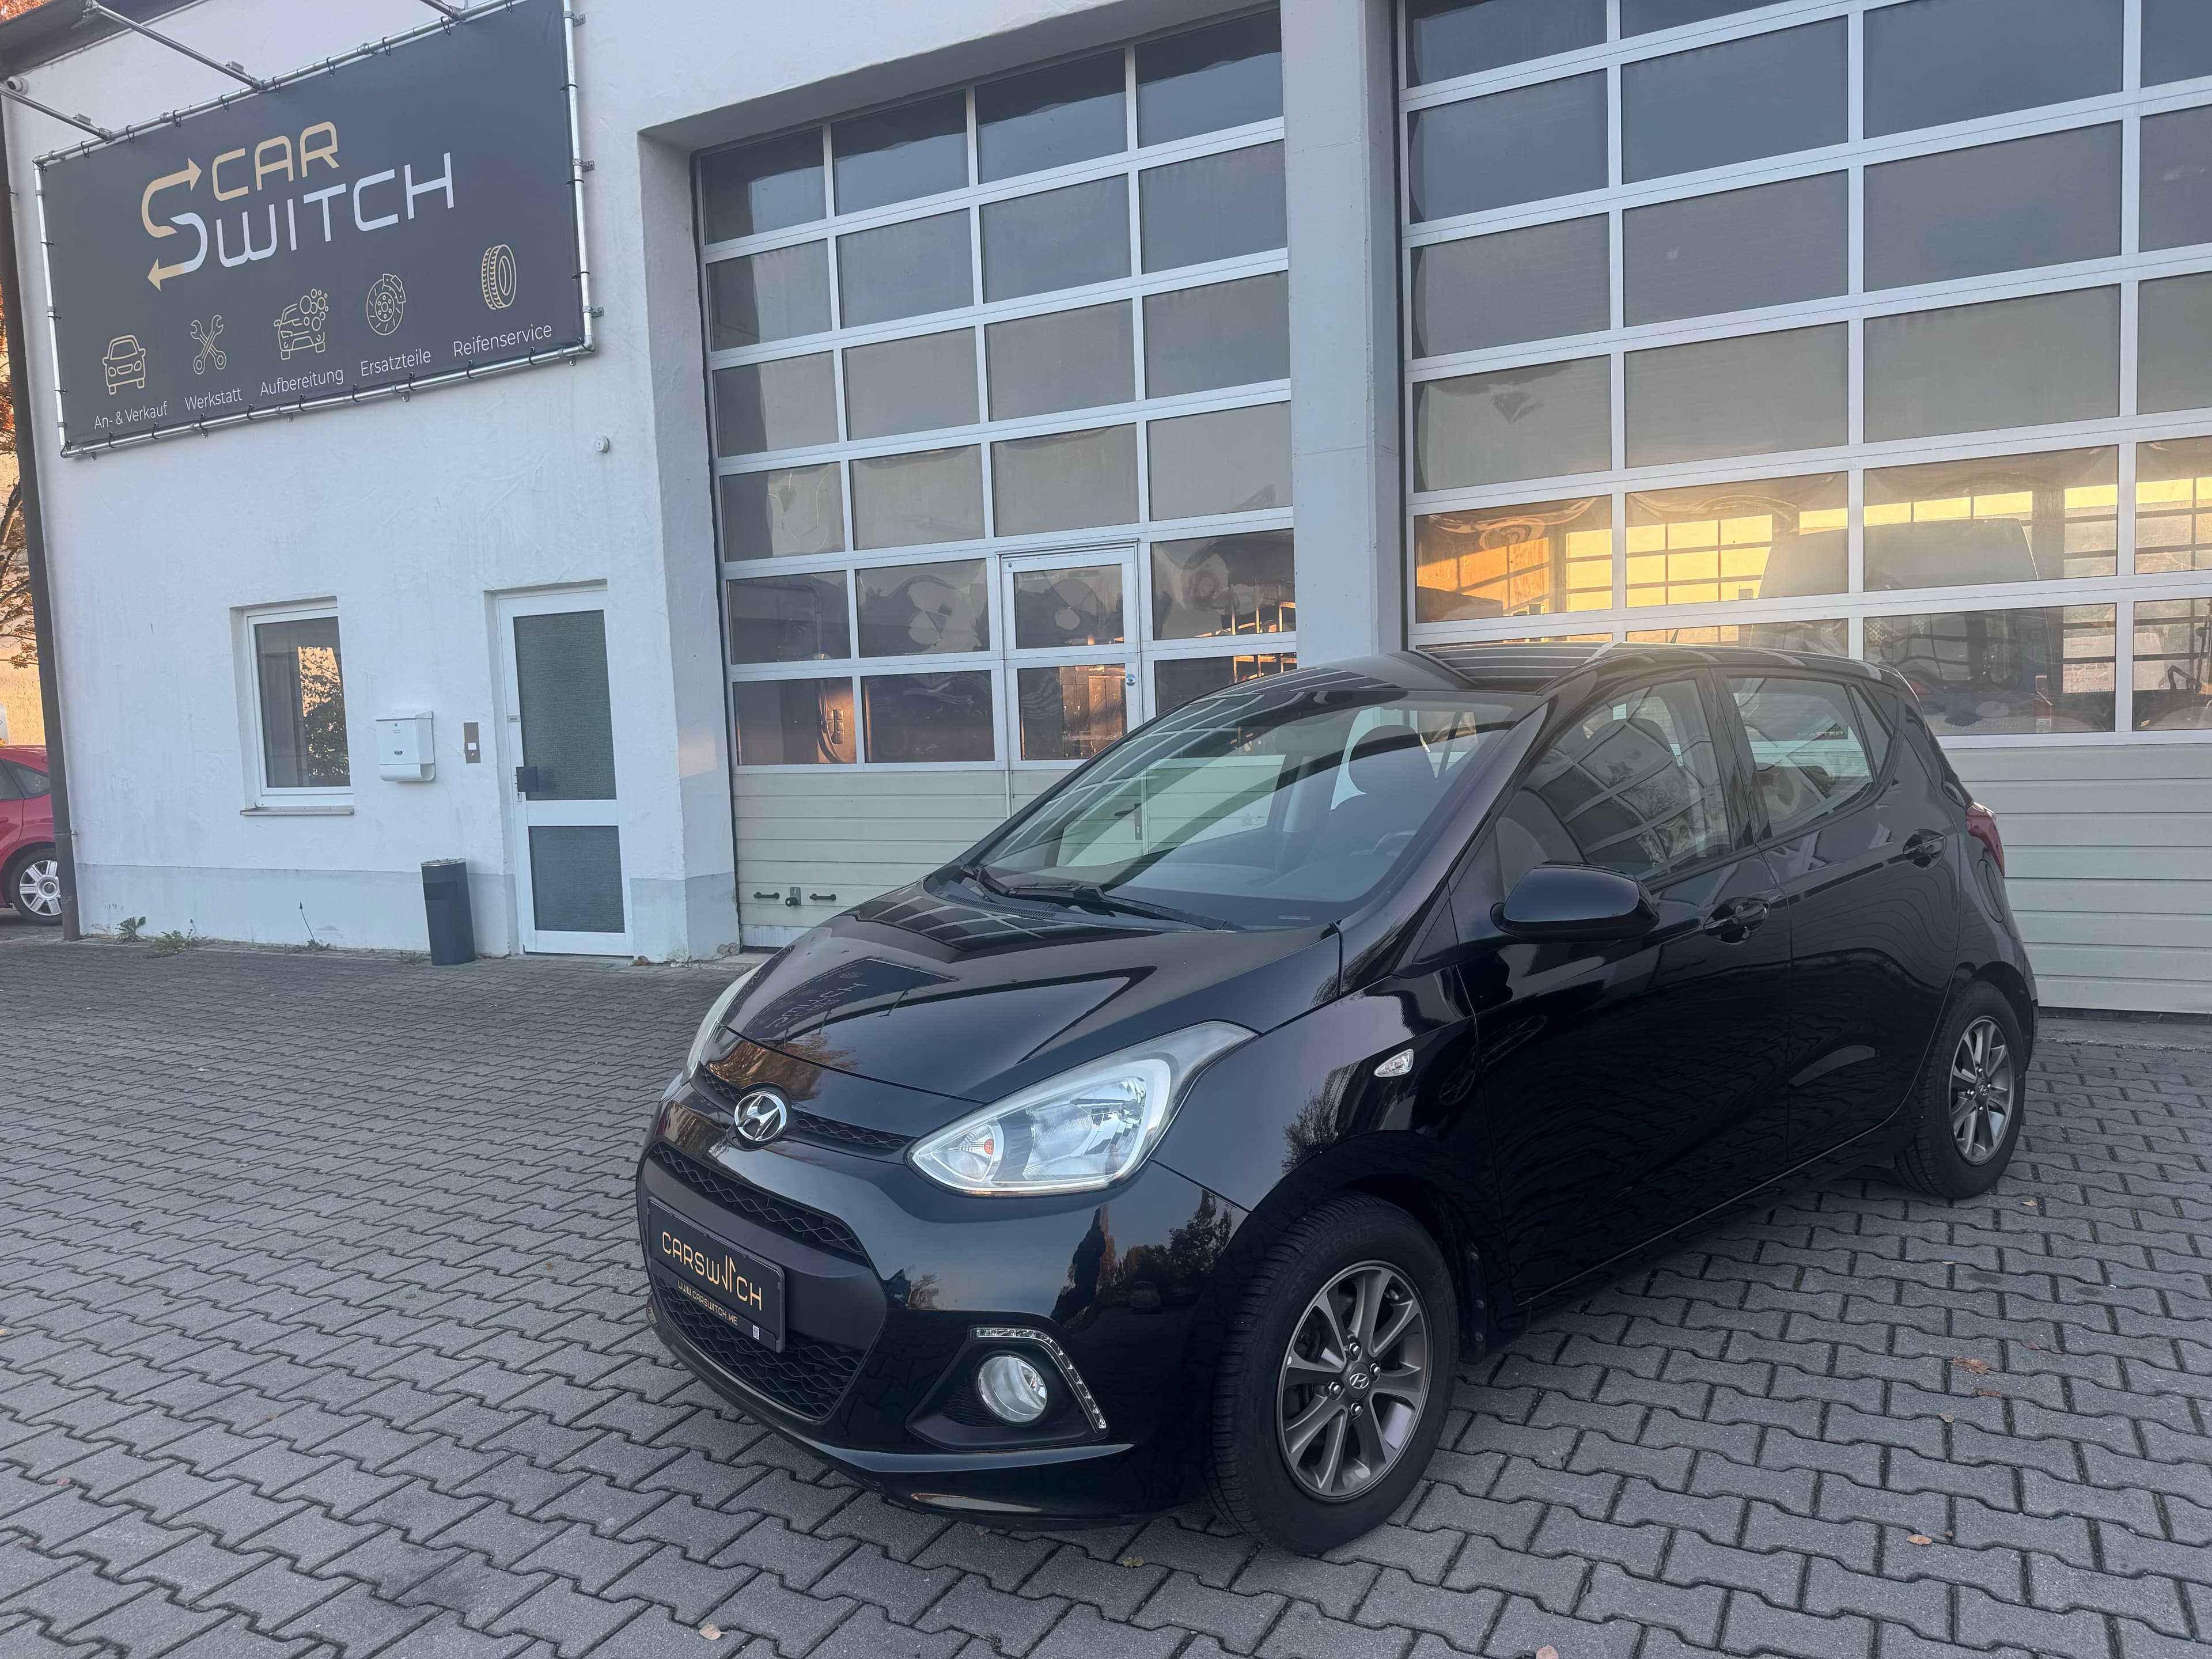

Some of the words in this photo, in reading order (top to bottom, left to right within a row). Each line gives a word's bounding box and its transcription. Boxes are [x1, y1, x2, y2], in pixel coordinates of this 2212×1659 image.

[212, 121, 340, 201] CAR
[142, 152, 454, 291] SWITCH
[453, 324, 552, 357] Reifenservice
[361, 348, 431, 377] Ersatzteile
[260, 368, 344, 396] Aufbereitung
[94, 415, 113, 429] An-
[116, 411, 123, 425] &
[124, 400, 168, 422] Verkauf
[184, 388, 243, 411] Werkstatt
[677, 1279, 738, 1326] WWW.CARSWITCH.ME
